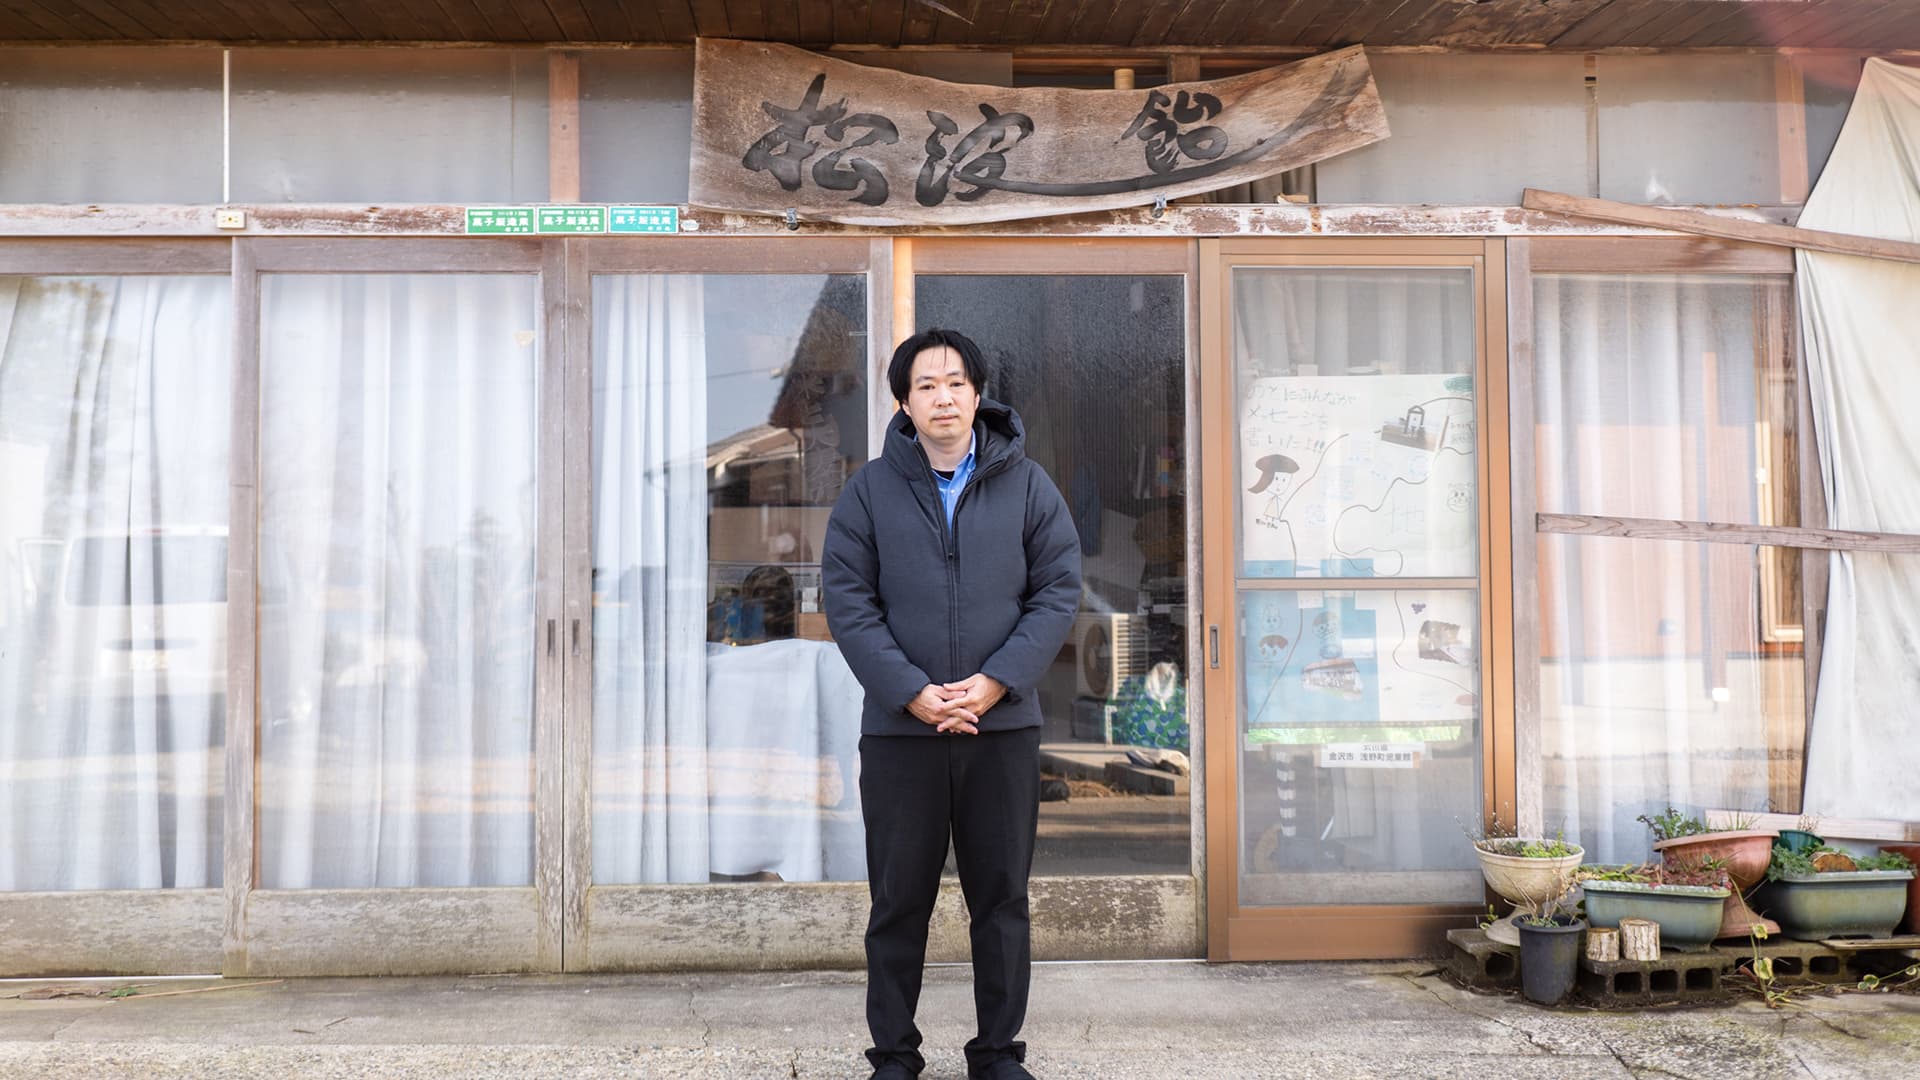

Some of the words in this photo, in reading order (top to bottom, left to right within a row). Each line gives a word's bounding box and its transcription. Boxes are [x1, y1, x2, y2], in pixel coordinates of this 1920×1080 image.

[472, 217, 529, 226] 菓子製造業
[543, 216, 600, 225] 菓子製造業
[615, 216, 671, 225] 菓子製造業
[1329, 752, 1354, 761] 金沢市
